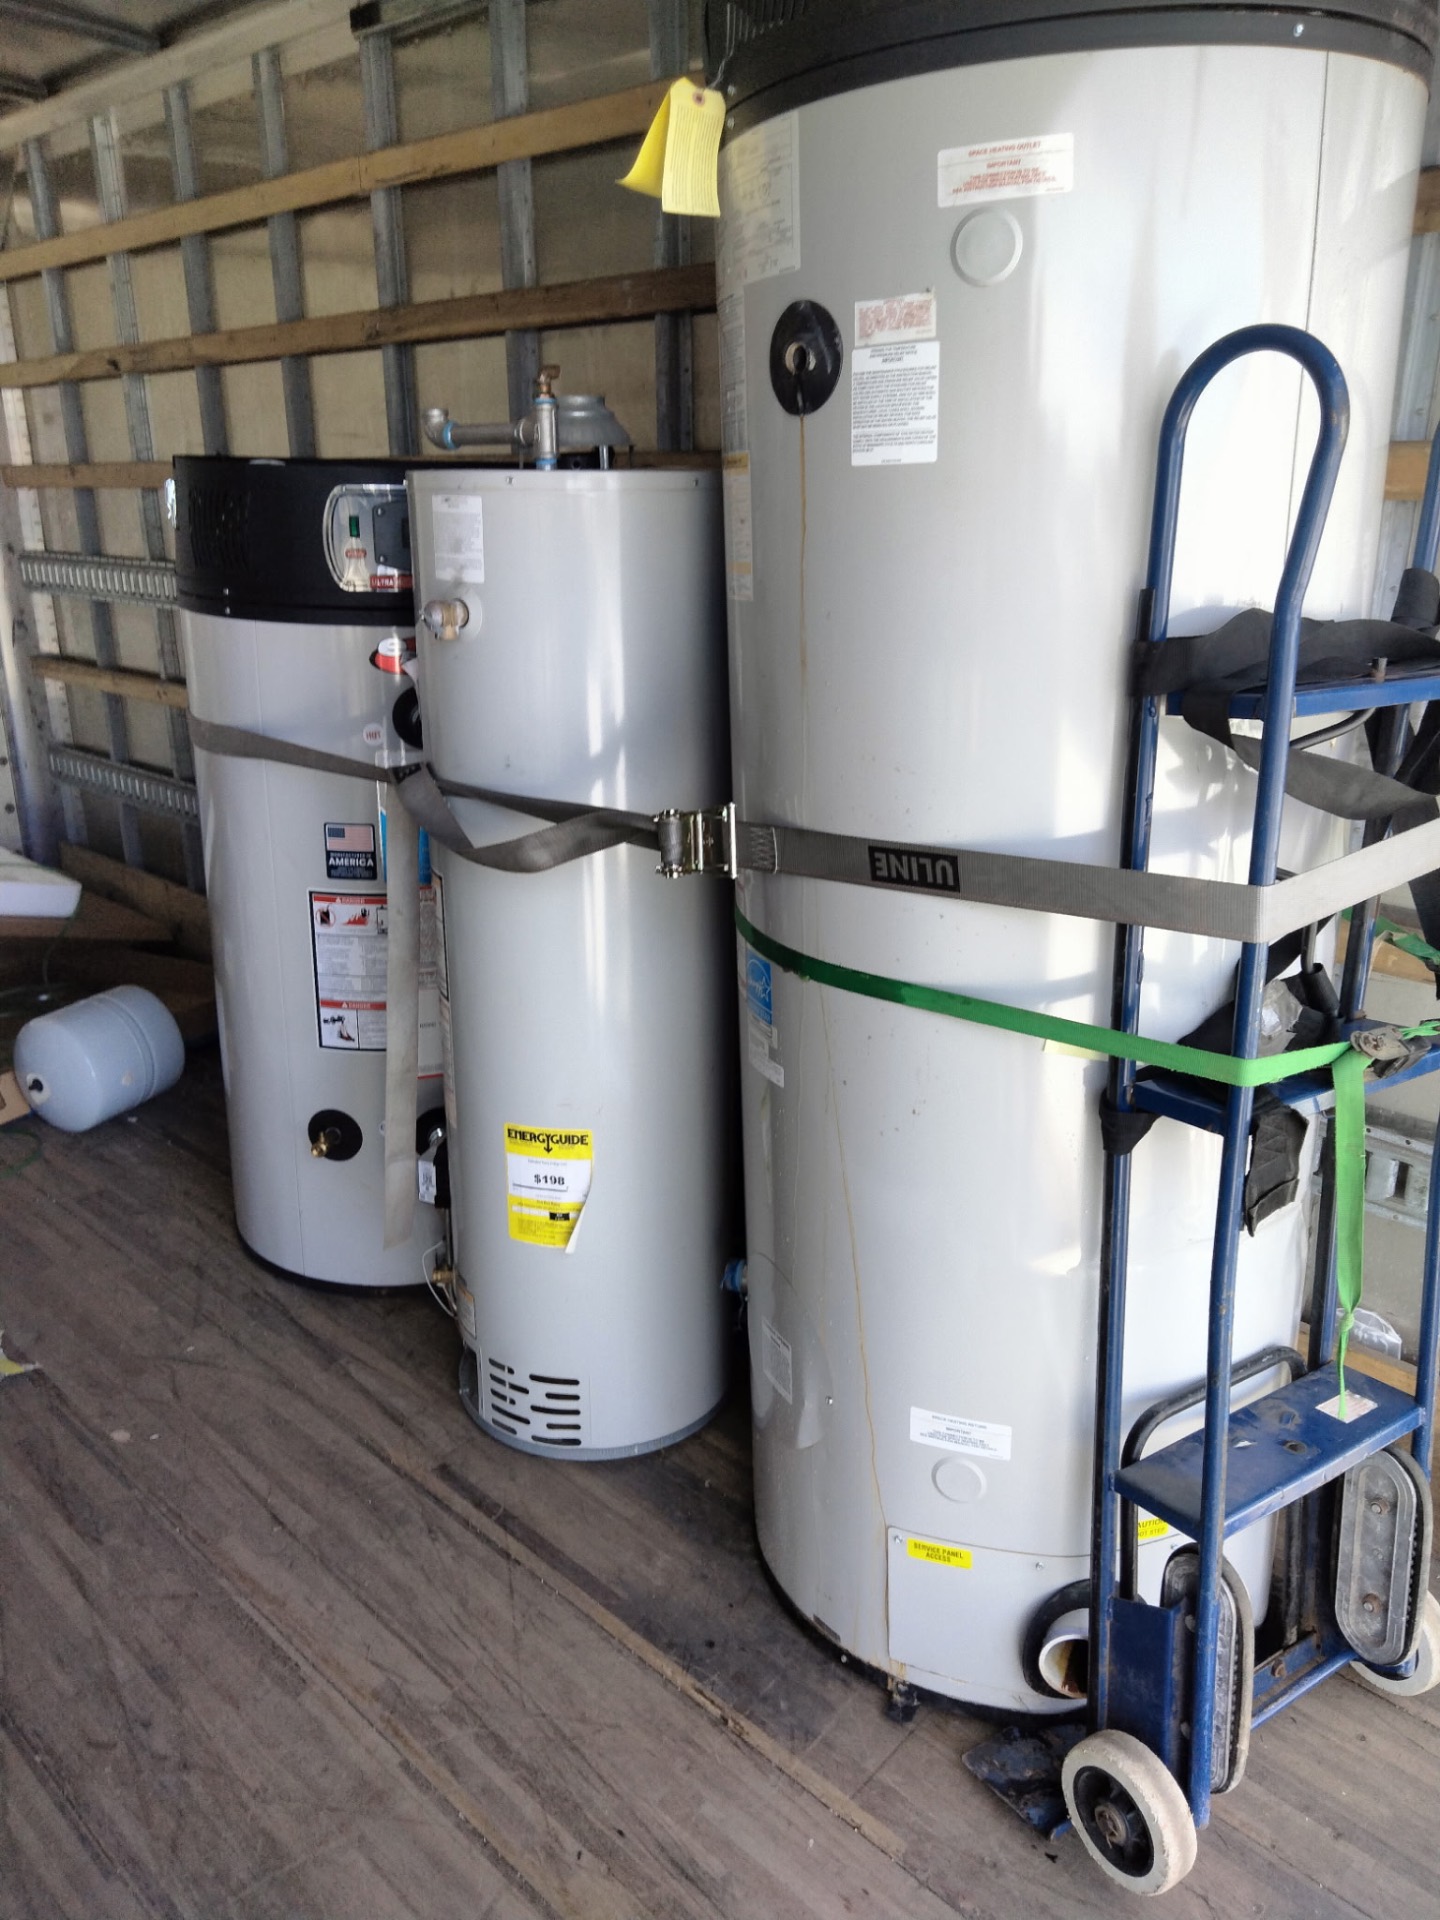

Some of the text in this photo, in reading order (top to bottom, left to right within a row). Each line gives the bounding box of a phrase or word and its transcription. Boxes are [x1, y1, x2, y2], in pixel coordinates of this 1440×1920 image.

[329, 857, 374, 867] AMERICA
[873, 852, 954, 886] ULINE
[507, 1128, 589, 1147] ENERGYGUIDE
[533, 1173, 565, 1186] $198
[914, 1542, 964, 1559] SERVICE PANEL
[926, 1552, 951, 1563] ACCESS
